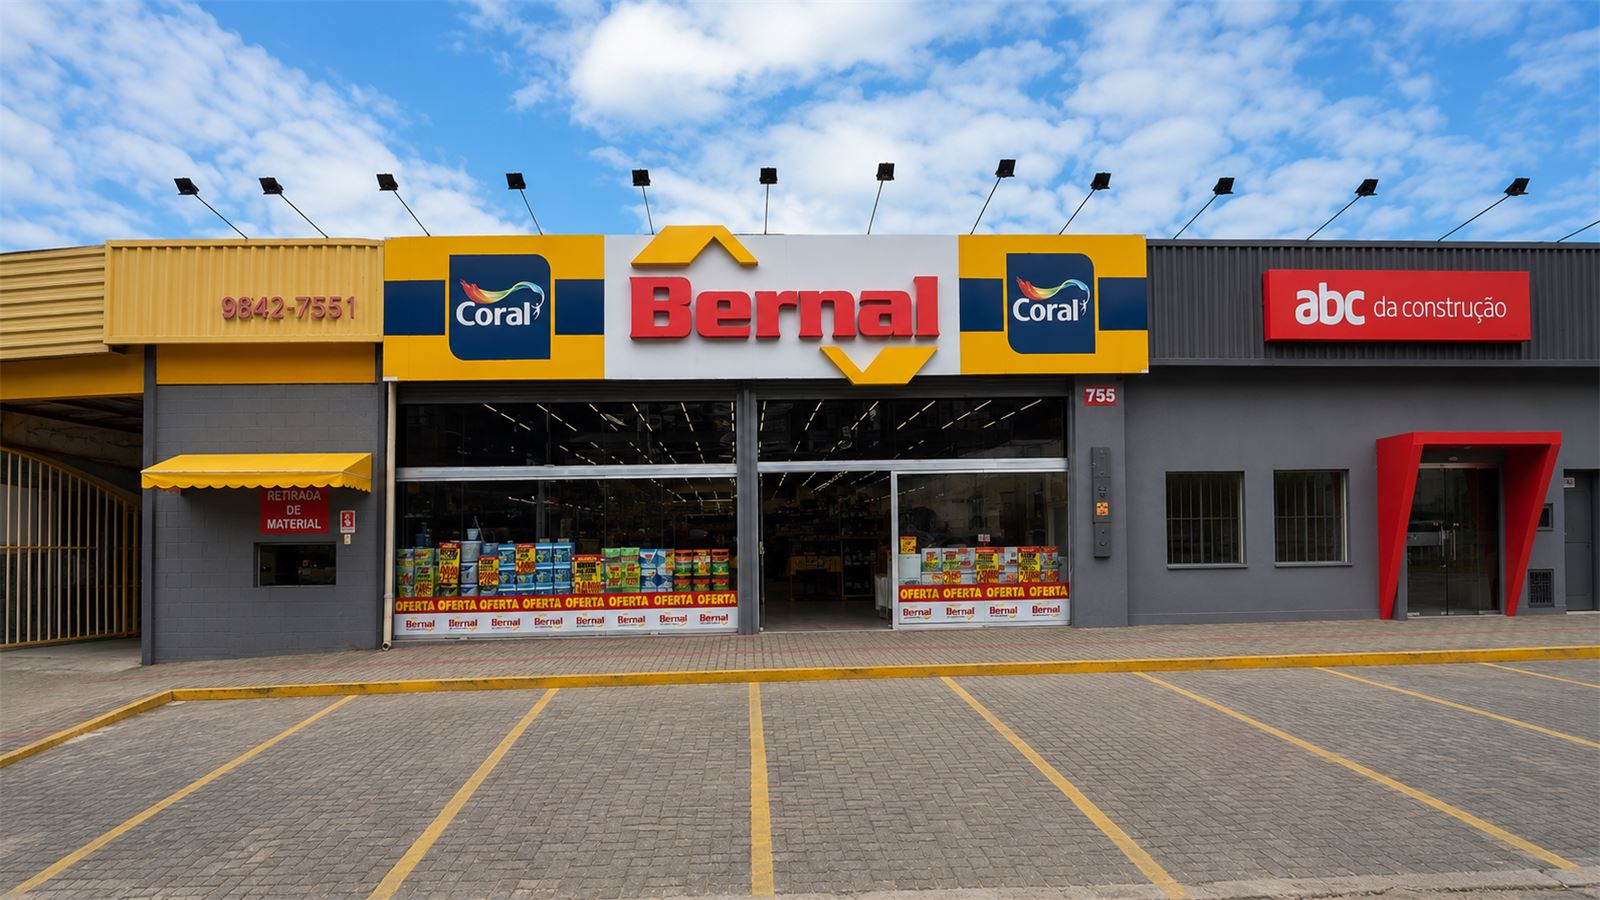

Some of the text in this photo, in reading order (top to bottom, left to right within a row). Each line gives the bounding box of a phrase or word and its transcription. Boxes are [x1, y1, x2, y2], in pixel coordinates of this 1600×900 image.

[221, 296, 356, 320] 9842-7551
[630, 276, 939, 340] Bernal
[1295, 282, 1507, 326] abc da construção
[455, 301, 531, 326] Coral
[1012, 298, 1079, 322] Coral
[1086, 388, 1116, 402] 755
[267, 490, 321, 501] RETIRADA
[286, 505, 301, 516] DE
[267, 519, 321, 529] MATERIAL
[900, 586, 1068, 599] OFERTA OFERTA OFERTA OFERTA
[395, 593, 737, 612] OFERTA OFERTA OFERTA OFERTA OFERTA OFERTA OFERTA OFERTA
[903, 608, 932, 616] Bernal
[946, 607, 975, 616] Bernal
[989, 606, 1018, 615] Bernal
[1032, 605, 1061, 614] Bernal
[534, 617, 563, 626] Bernal
[576, 616, 604, 625] Bernal
[617, 616, 645, 624] Bernal
[659, 615, 688, 623] Bernal
[699, 613, 729, 622] Bernal
[405, 620, 435, 629] Bernal
[449, 619, 478, 628] Bernal
[491, 618, 521, 627] Bernal
